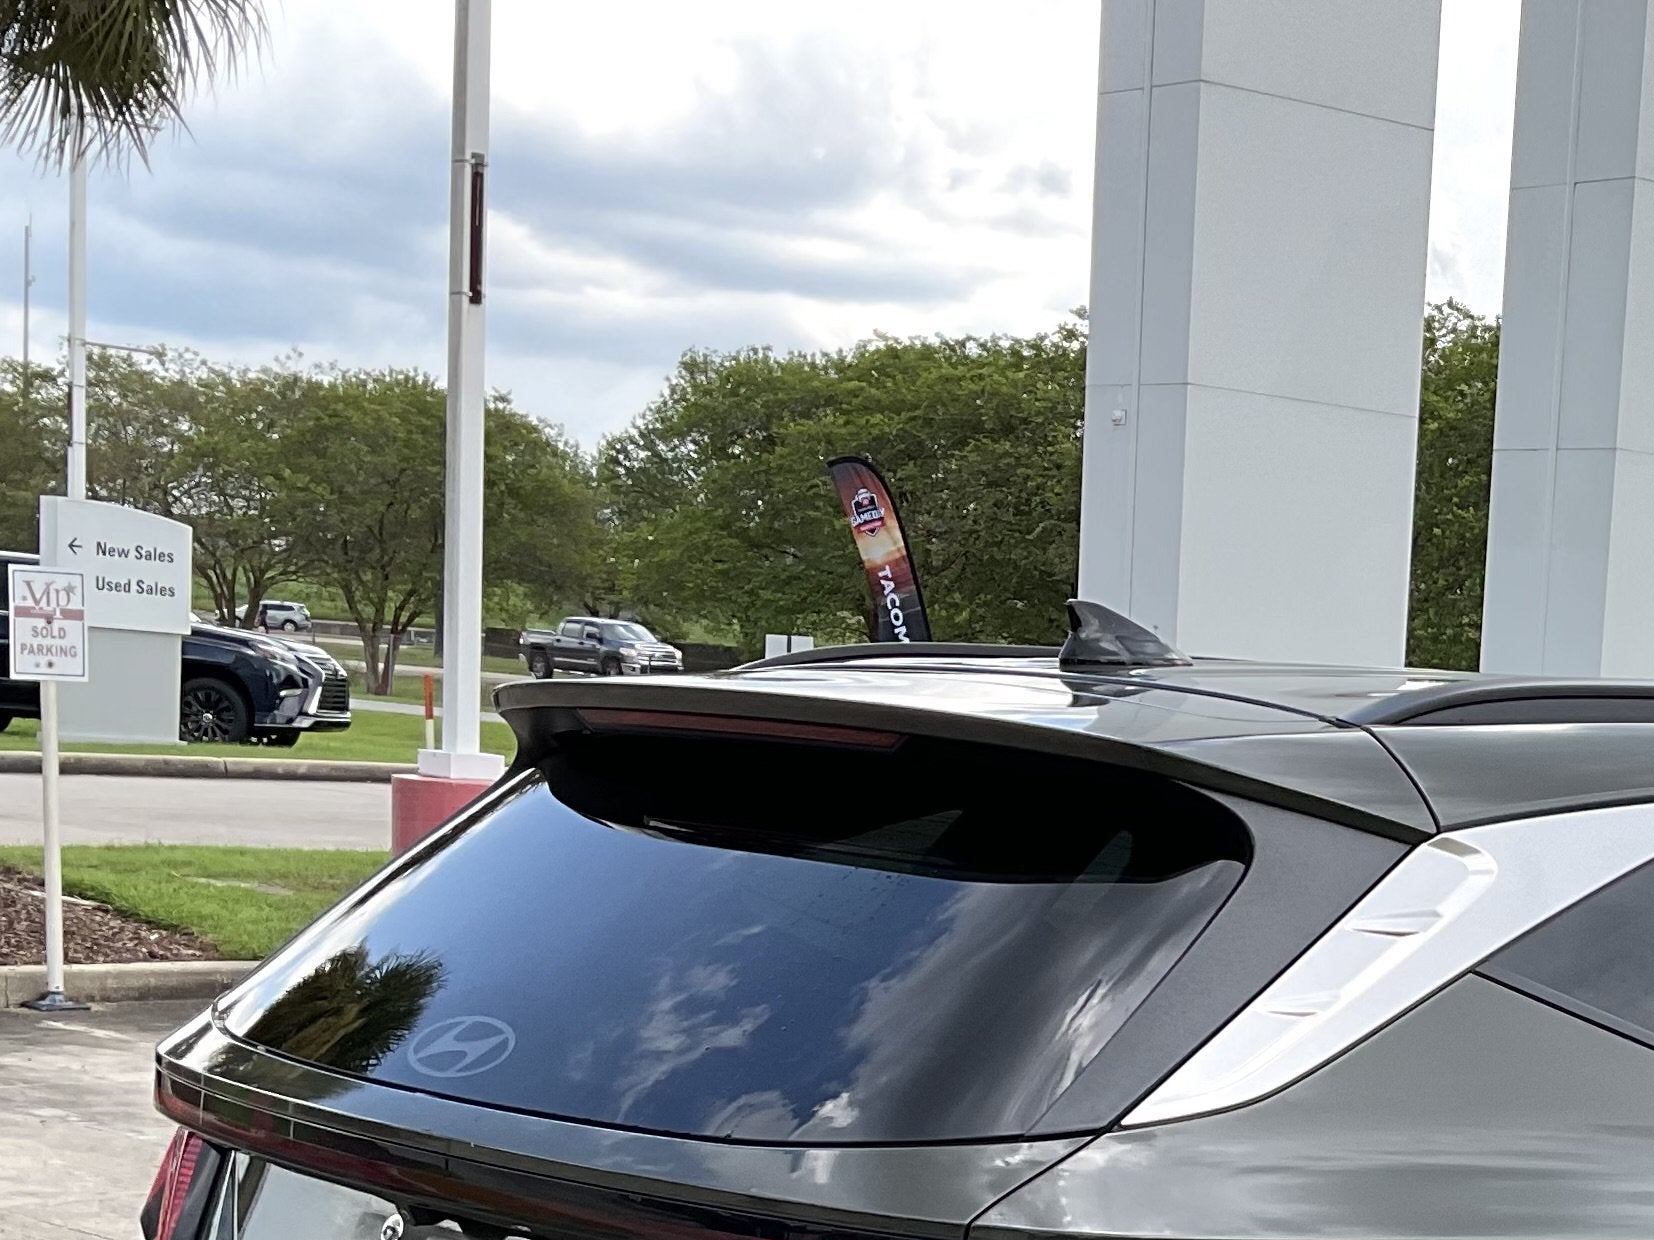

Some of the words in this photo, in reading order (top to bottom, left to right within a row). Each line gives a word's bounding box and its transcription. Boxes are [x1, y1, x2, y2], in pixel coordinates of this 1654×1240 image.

[96, 541, 130, 559] New
[135, 545, 174, 563] Sales
[96, 576, 131, 593] Used
[136, 579, 175, 598] Sales
[31, 625, 67, 639] SOLD
[20, 642, 78, 658] PARKING
